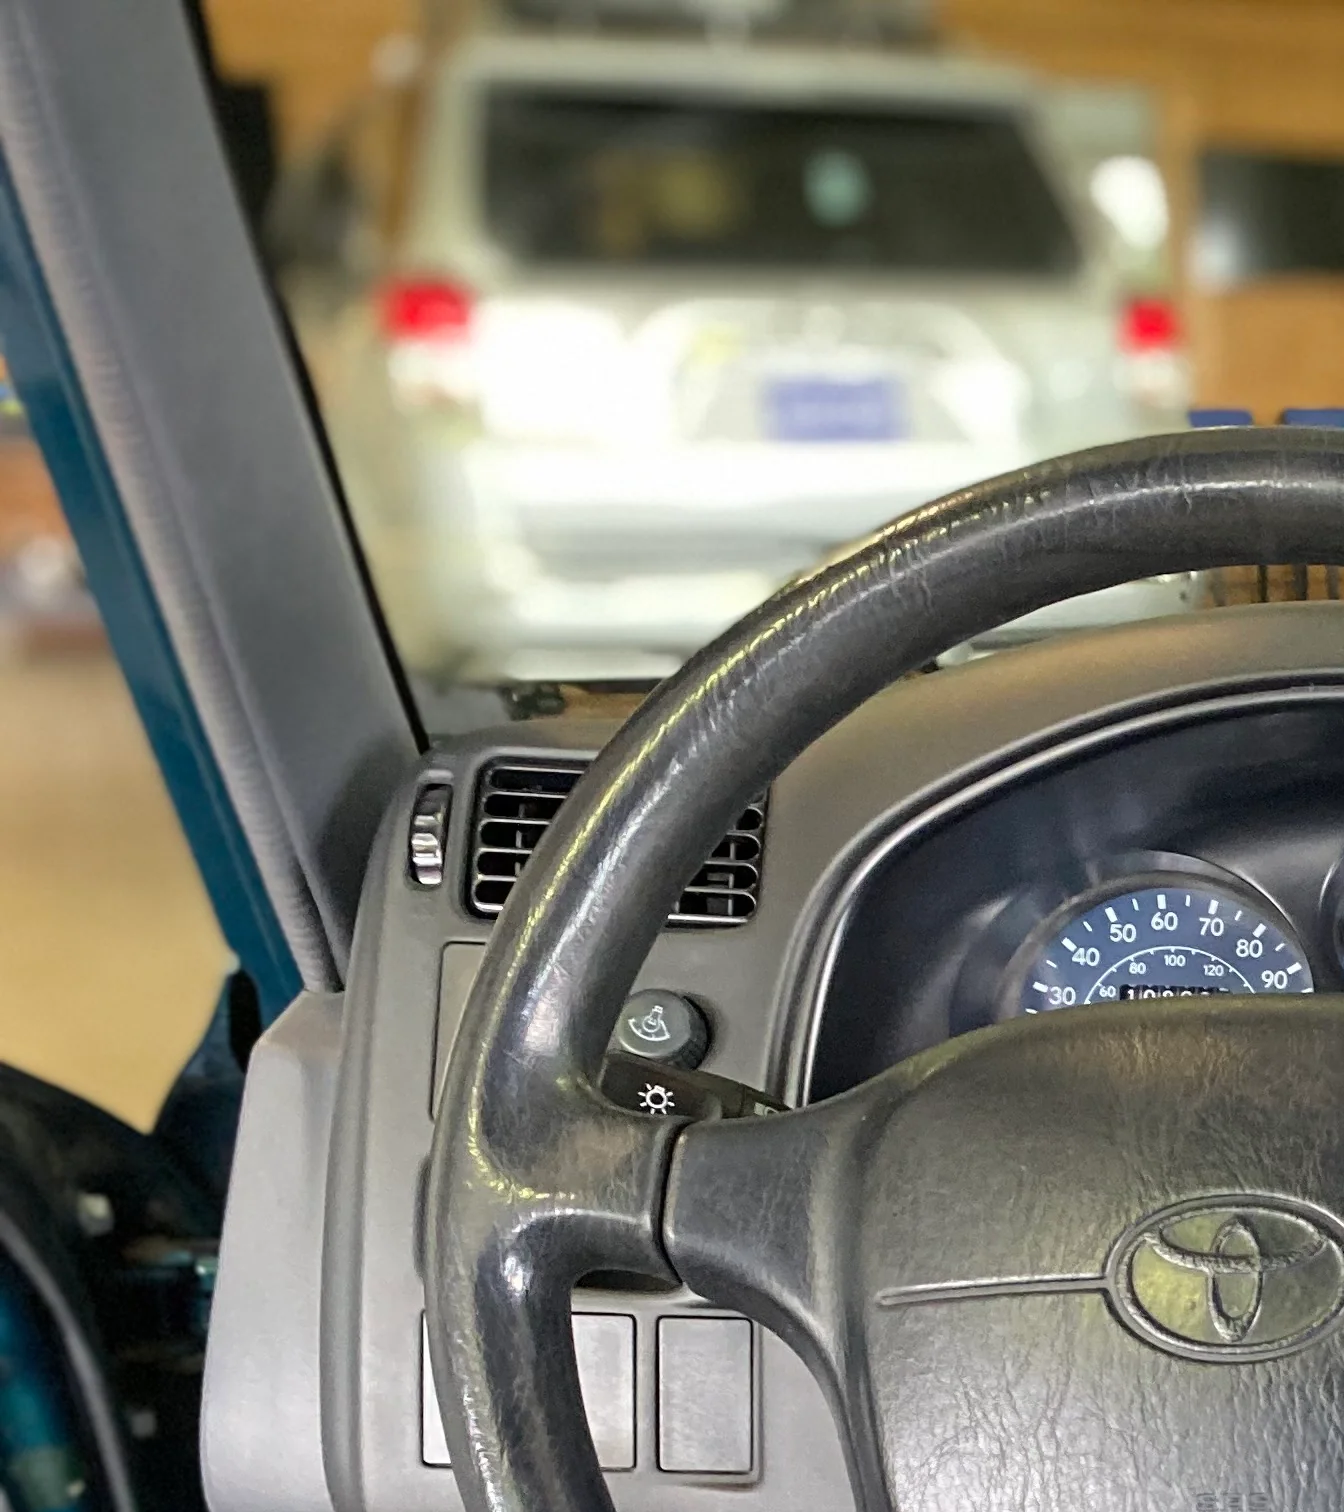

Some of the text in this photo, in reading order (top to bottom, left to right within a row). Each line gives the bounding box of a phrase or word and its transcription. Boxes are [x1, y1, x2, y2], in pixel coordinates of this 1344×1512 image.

[1151, 912, 1178, 930] 60
[1199, 918, 1224, 936] 70
[1110, 924, 1136, 942] 50
[1071, 946, 1100, 966] 40
[1236, 939, 1262, 958] 80
[1129, 962, 1146, 974] 80
[1164, 955, 1185, 966] 100
[1204, 963, 1225, 976] 120
[1262, 969, 1289, 989] 90
[1049, 987, 1076, 1005] 30
[1099, 984, 1116, 997] 60
